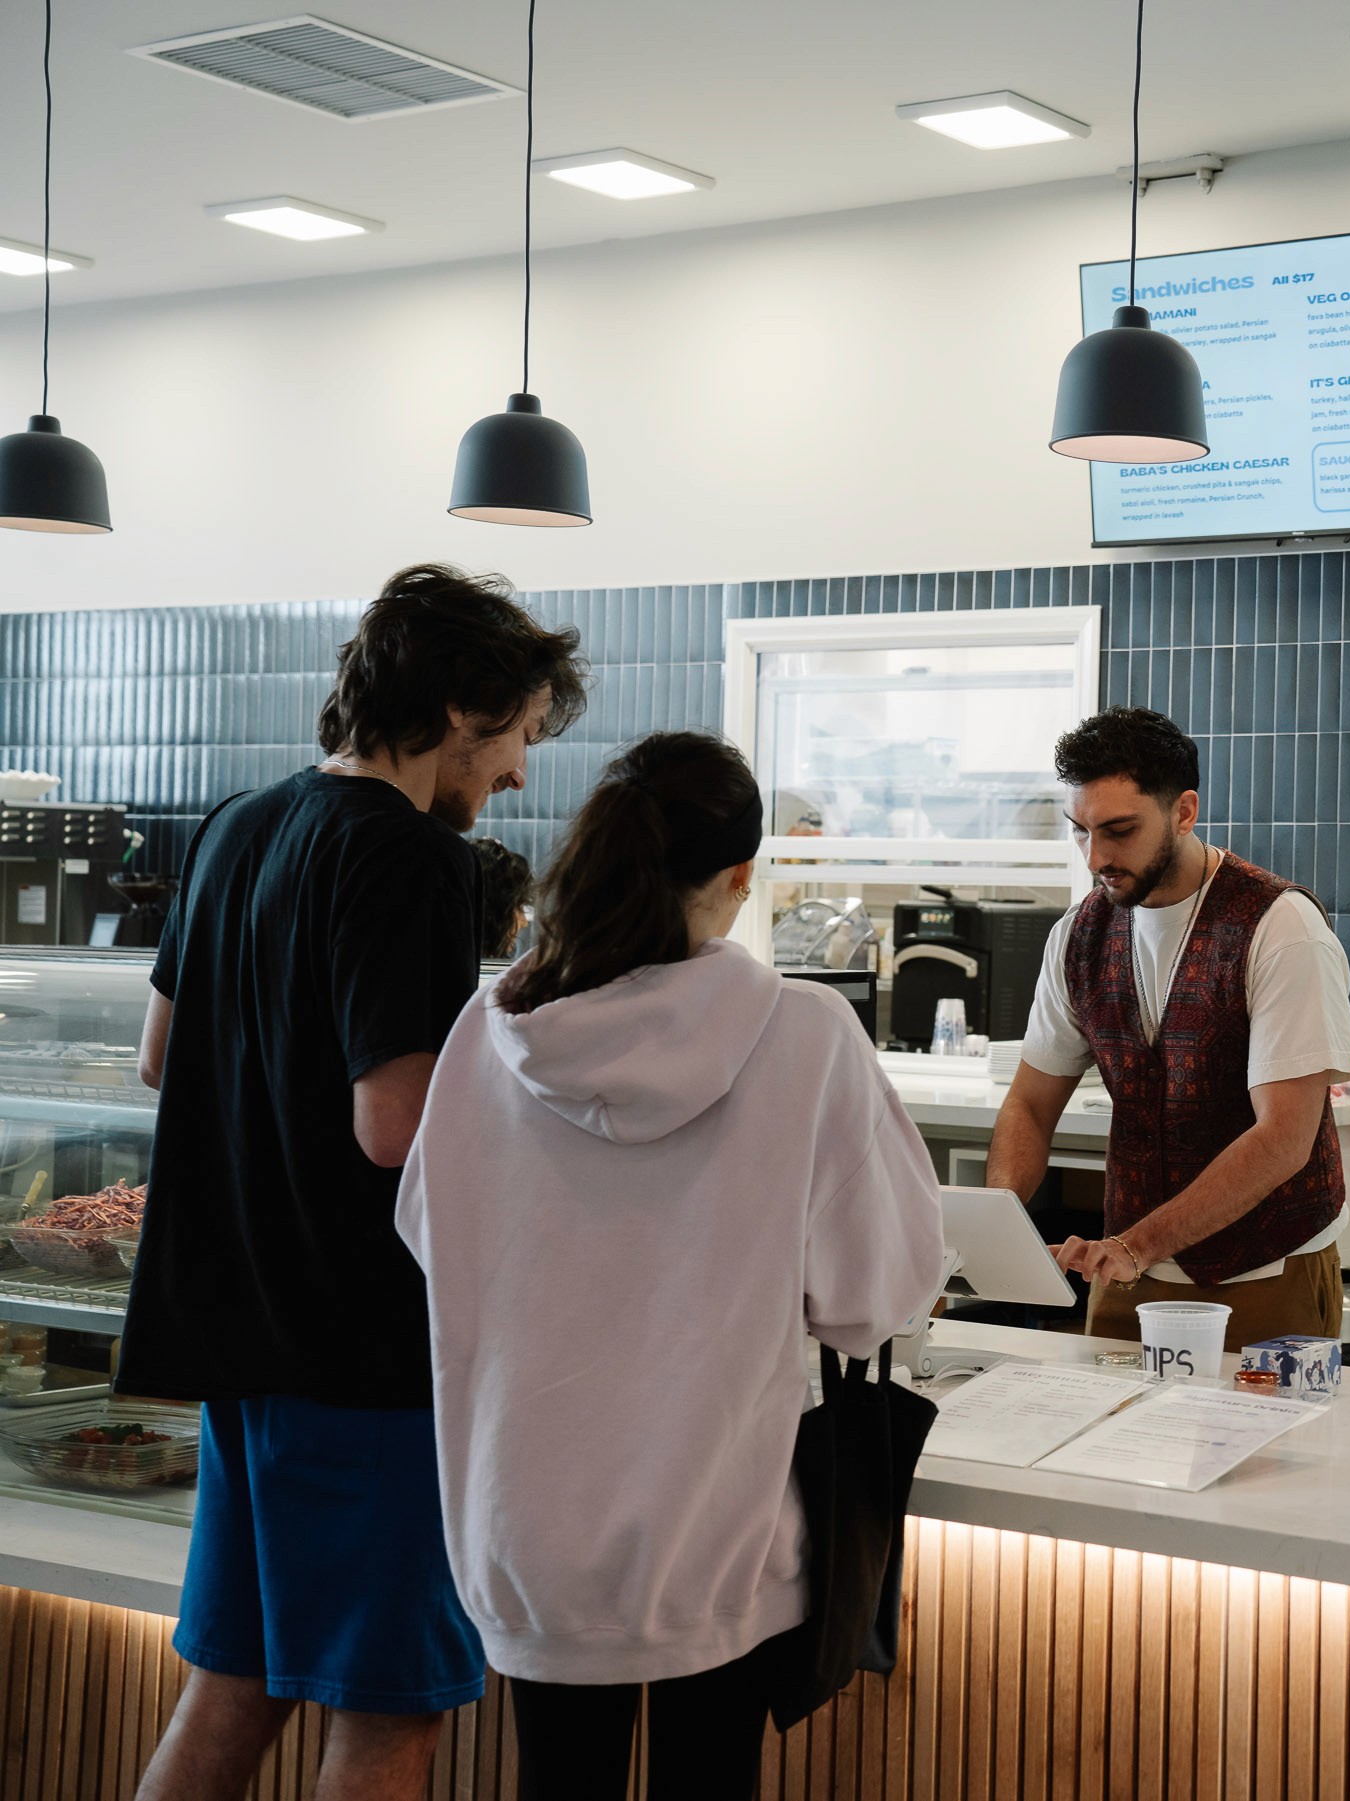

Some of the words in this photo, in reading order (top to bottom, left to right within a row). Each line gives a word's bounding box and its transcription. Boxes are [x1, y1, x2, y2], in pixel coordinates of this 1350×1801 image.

[1272, 275, 1289, 285] All
[1292, 272, 1315, 284] $17
[1307, 293, 1337, 304] VEG
[1310, 377, 1334, 388] IT'S
[1120, 466, 1168, 478] BABA'S
[1171, 462, 1230, 474] CHICKEN
[1232, 457, 1290, 470] CAESAR
